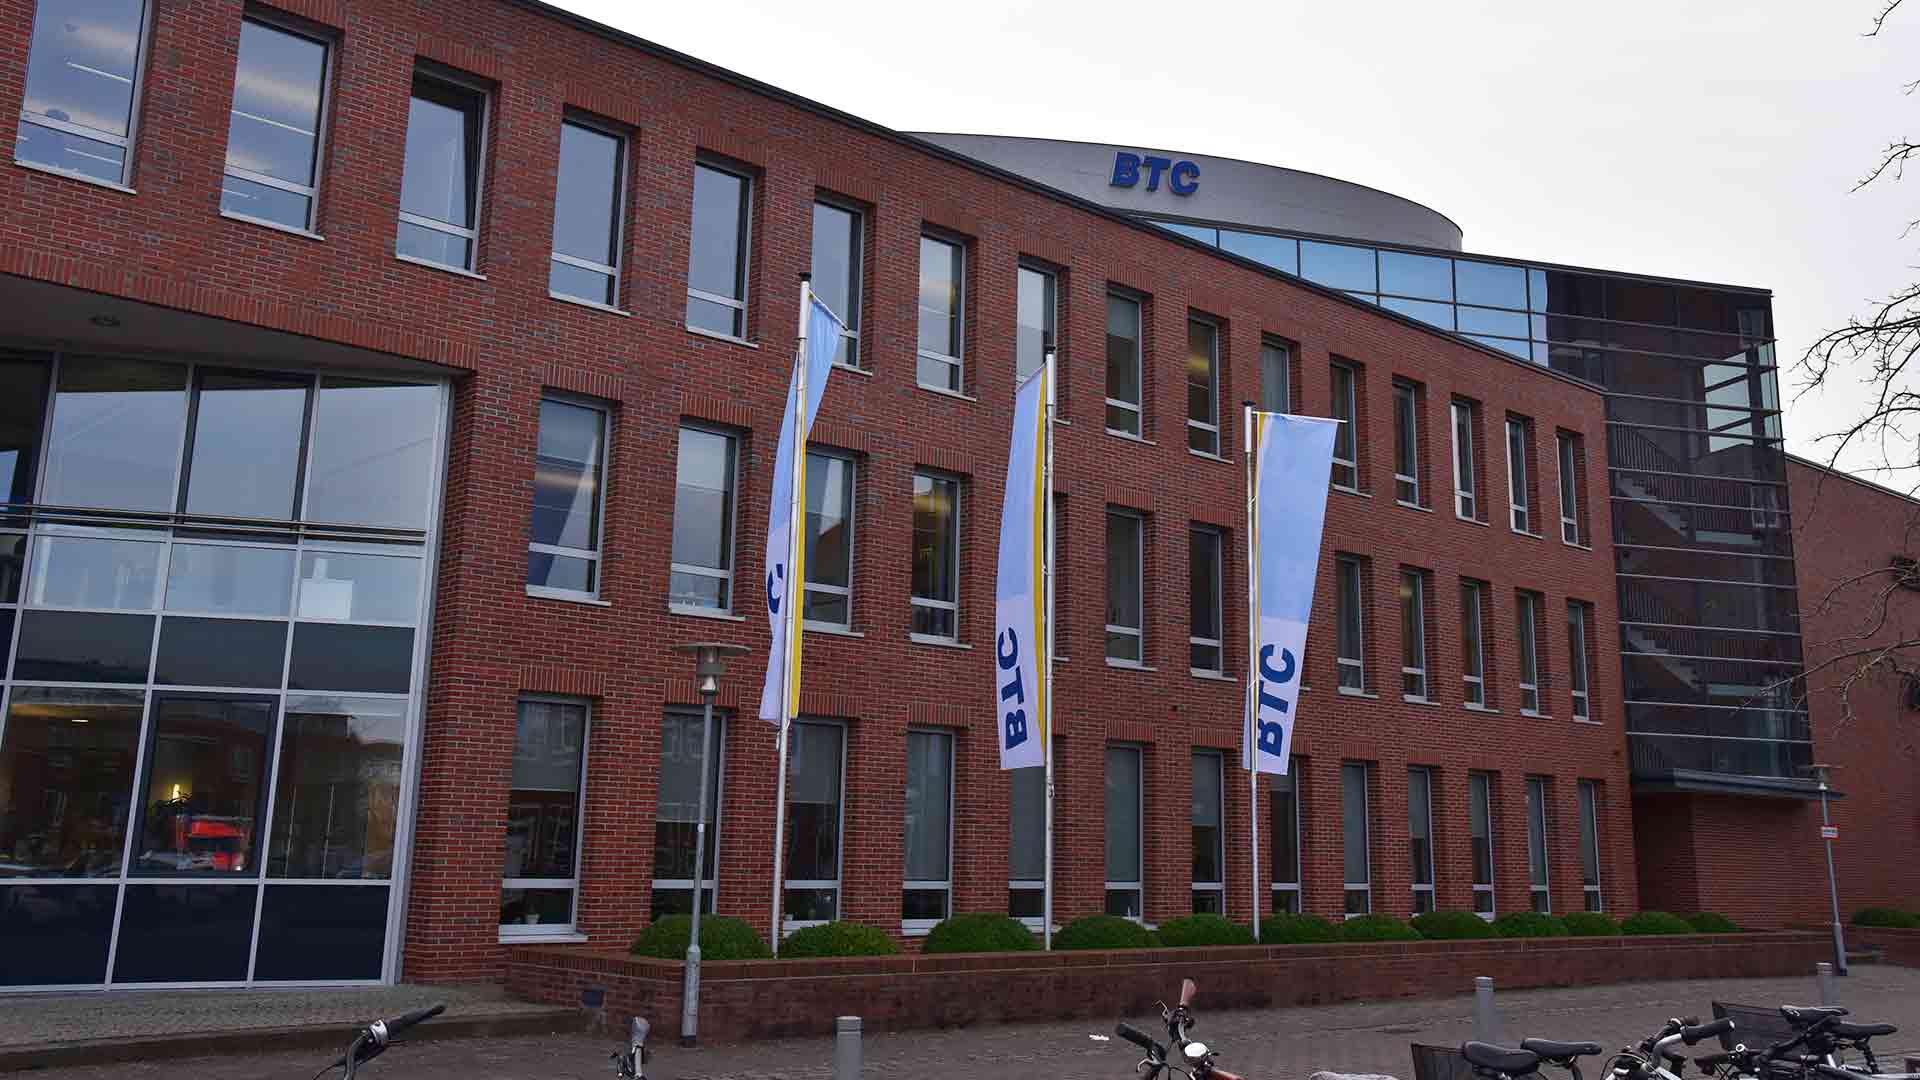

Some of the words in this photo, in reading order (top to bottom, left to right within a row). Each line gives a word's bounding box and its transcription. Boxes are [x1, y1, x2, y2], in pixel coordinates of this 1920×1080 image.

[1110, 152, 1200, 194] BTC
[998, 627, 1027, 750] BTC
[1257, 644, 1295, 757] BTC
